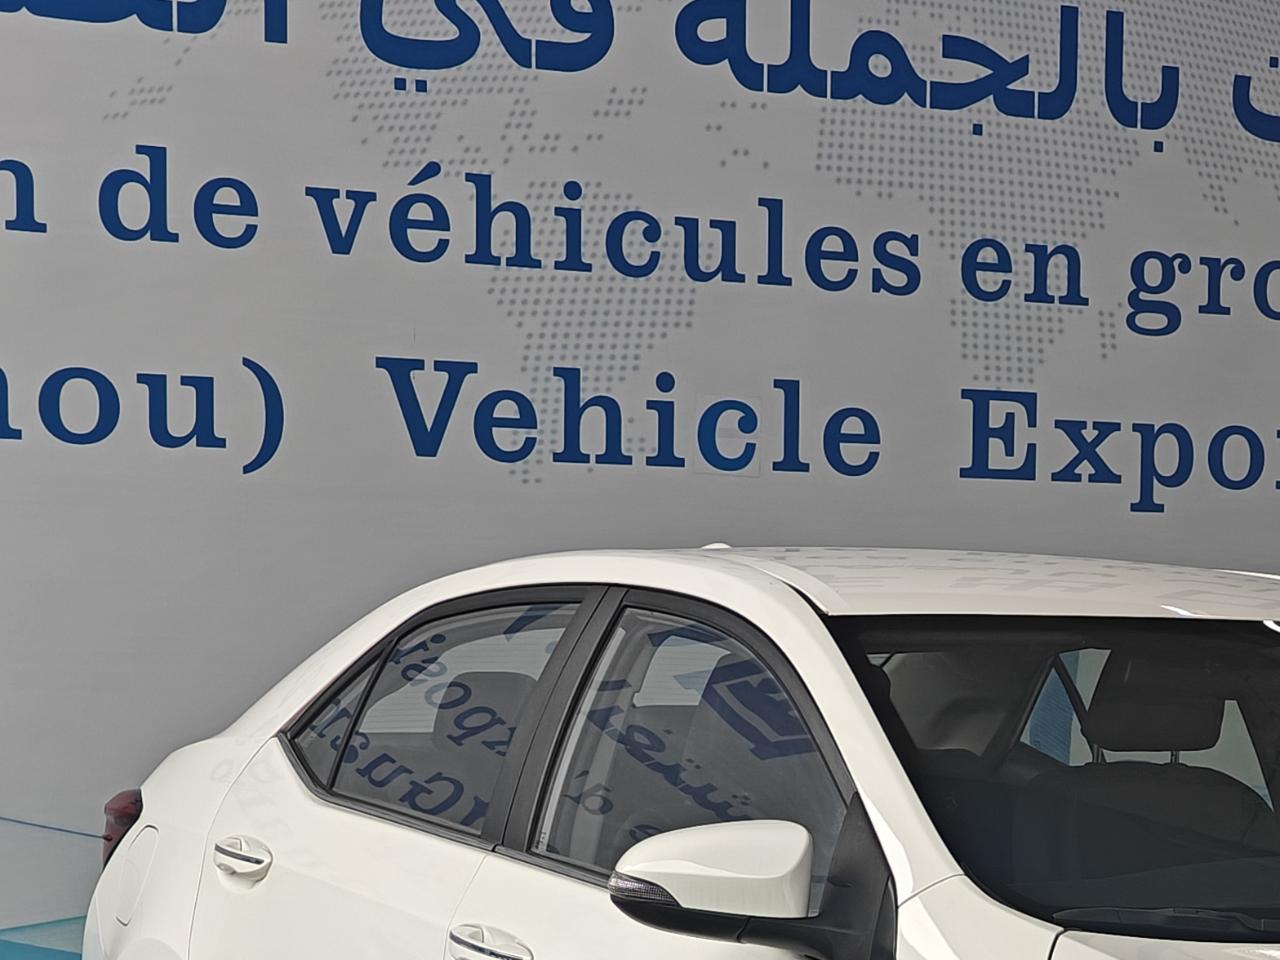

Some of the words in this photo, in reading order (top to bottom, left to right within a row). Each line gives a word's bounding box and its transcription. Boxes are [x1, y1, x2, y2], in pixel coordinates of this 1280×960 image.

[97, 144, 260, 250] de
[305, 160, 922, 296] véhicules
[960, 234, 1090, 307] en
[0, 356, 285, 475] ou)
[375, 356, 882, 478] Vehicle
